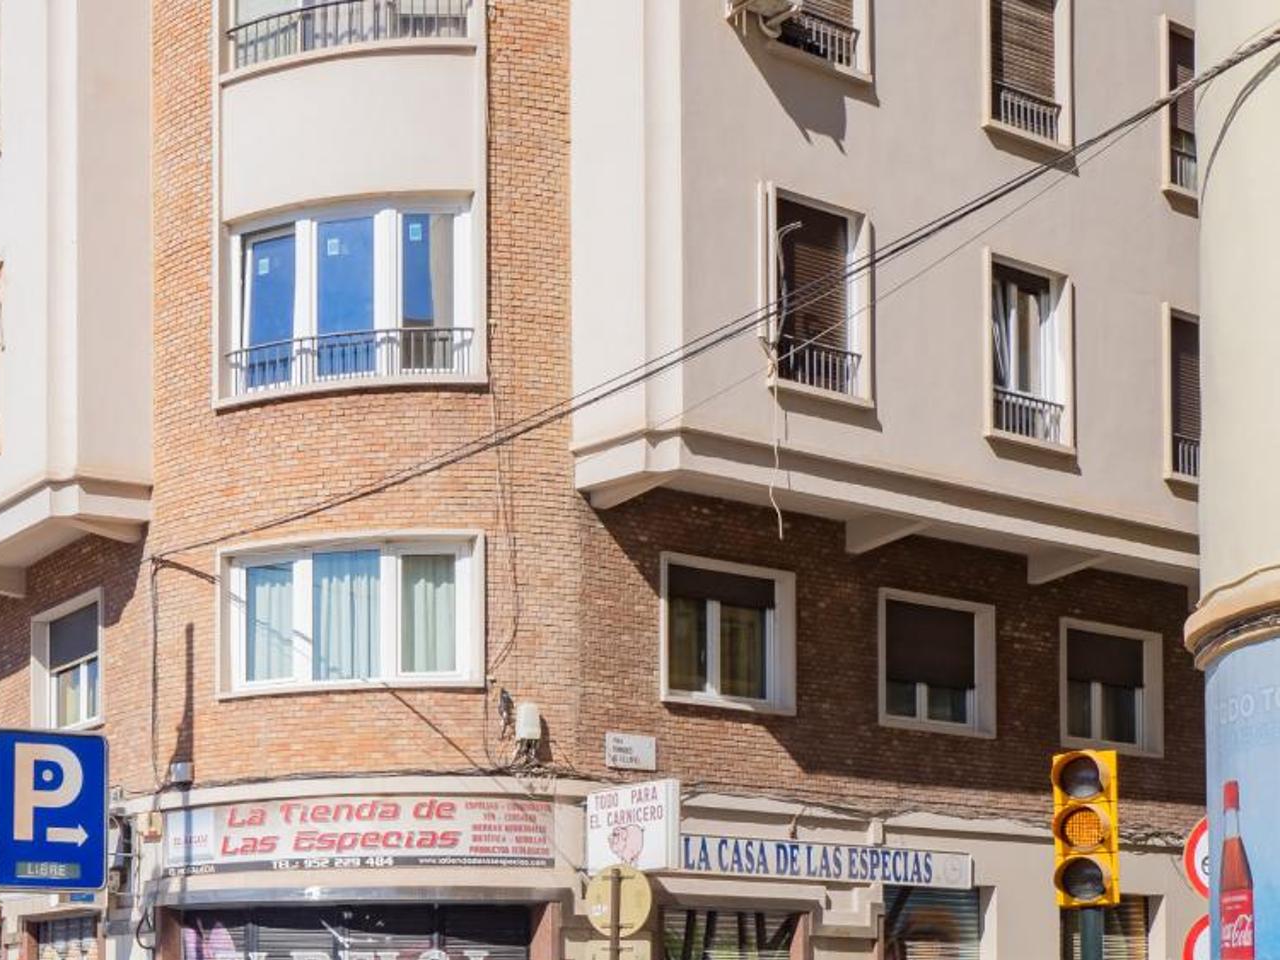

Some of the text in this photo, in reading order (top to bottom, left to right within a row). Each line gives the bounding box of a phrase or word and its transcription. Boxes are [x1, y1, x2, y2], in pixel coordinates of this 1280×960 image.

[13, 742, 83, 841] P
[595, 786, 658, 811] TODO PARA
[227, 799, 456, 828] La Tienda de
[590, 805, 663, 829] EL CARNICERO
[221, 835, 279, 857] Las
[293, 829, 462, 853] Especias
[26, 862, 67, 876] LIBRE
[303, 859, 330, 868] 952
[683, 836, 933, 884] LA CASA DE LAS ESPECIAS
